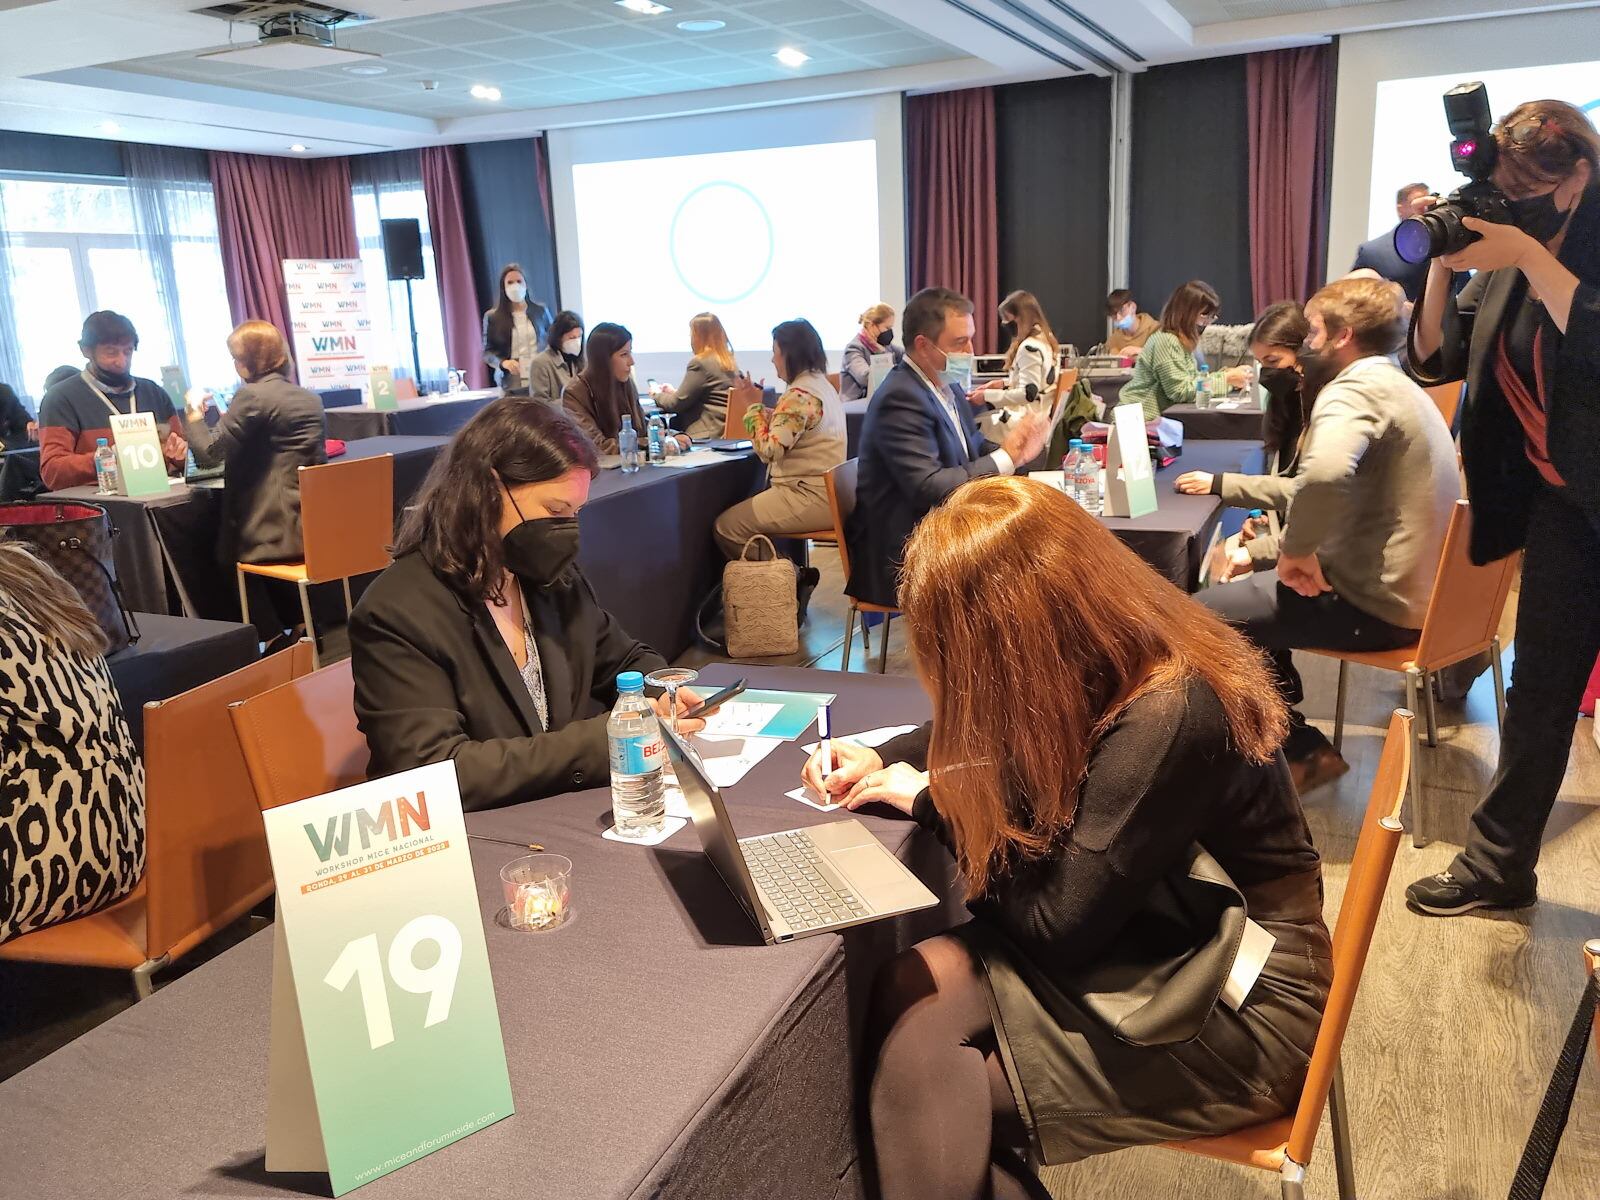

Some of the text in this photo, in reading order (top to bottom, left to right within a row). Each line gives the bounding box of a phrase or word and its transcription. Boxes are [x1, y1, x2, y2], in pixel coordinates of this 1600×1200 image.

[337, 300, 358, 308] WMN
[322, 320, 343, 328] WMN
[311, 335, 357, 352] WMN
[310, 366, 331, 374] WMN
[346, 364, 366, 372] WMN
[377, 380, 390, 395] 2
[118, 417, 148, 429] WMN
[123, 443, 159, 471] 10
[302, 790, 431, 863] WMN
[315, 835, 435, 877] WORKSHOP MICE NACIONAL
[350, 870, 361, 878] AL
[363, 866, 373, 875] 31
[374, 862, 385, 871] DE
[386, 853, 413, 868] MARZO
[415, 849, 425, 858] DE
[322, 914, 463, 1050] 19
[354, 1111, 496, 1182] www.miceandforuminside.com
